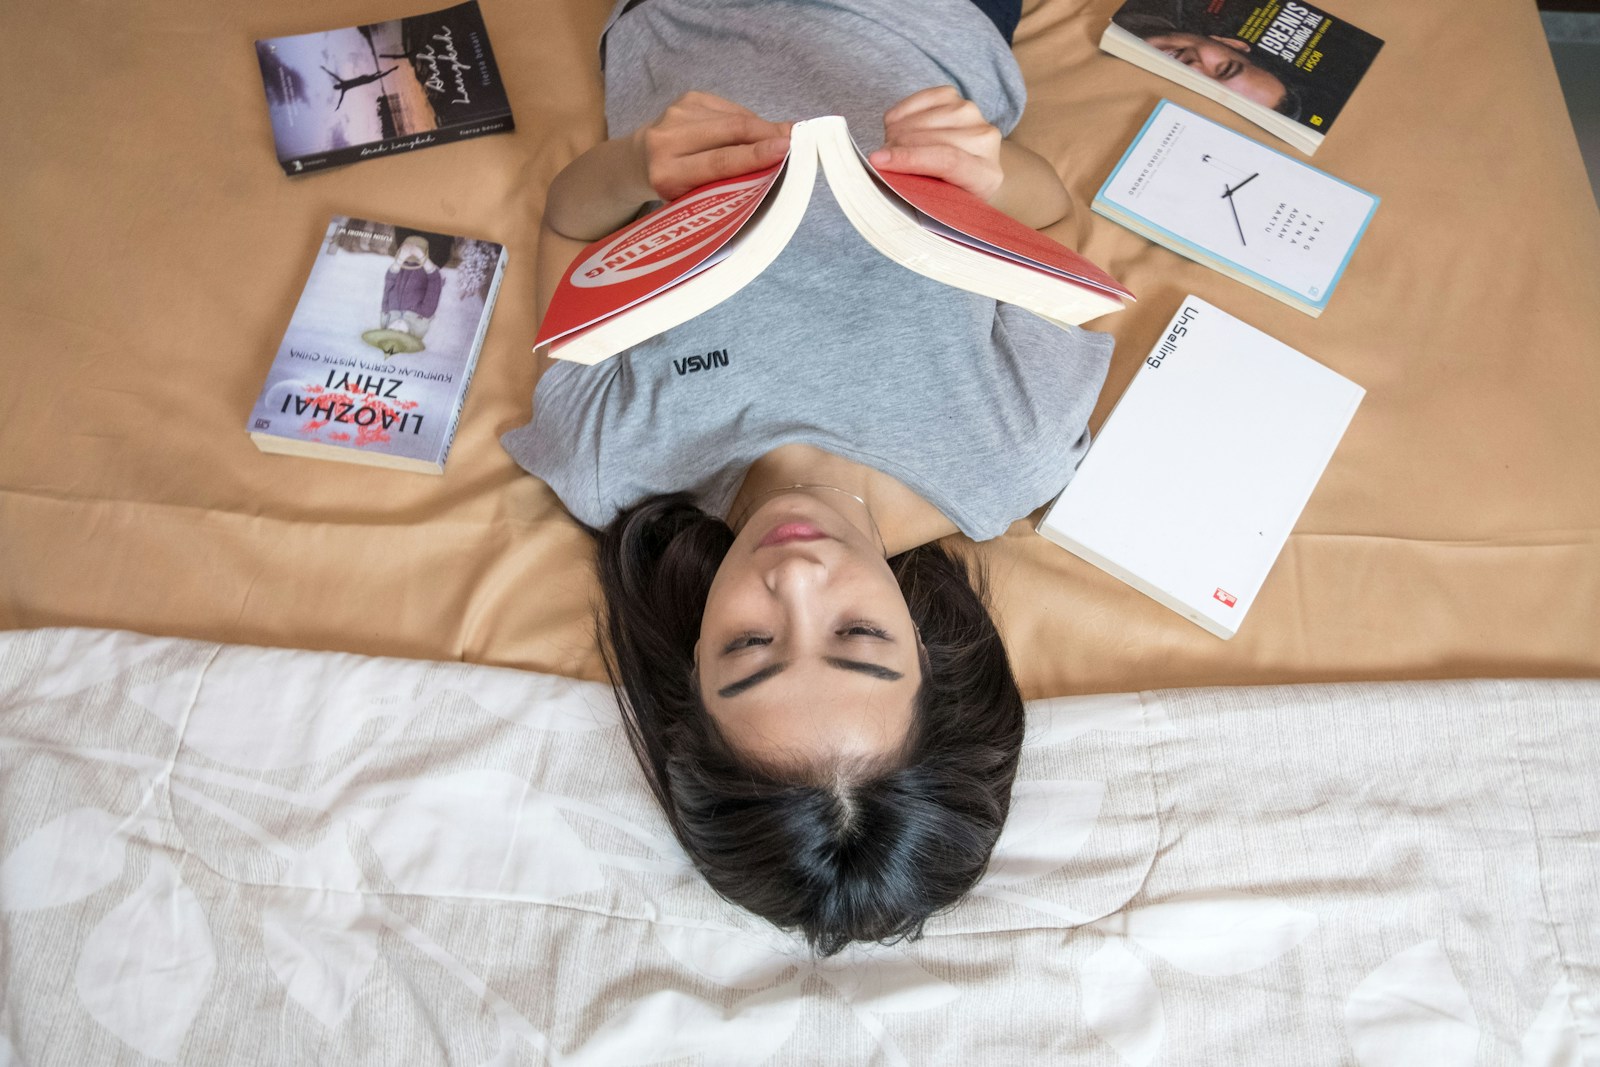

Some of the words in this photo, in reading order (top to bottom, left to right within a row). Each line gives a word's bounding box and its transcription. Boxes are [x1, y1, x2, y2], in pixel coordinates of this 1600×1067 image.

[1257, 1, 1309, 56] SINERGI
[1302, 11, 1324, 29] THE
[1285, 25, 1314, 53] POWER
[416, 44, 446, 93] Arah
[432, 25, 471, 104] Langkah
[1279, 49, 1296, 63] OF
[1161, 121, 1181, 148] SAPARDI
[1147, 147, 1163, 168] DJOKO
[1128, 168, 1149, 196] DAMONO
[1264, 202, 1286, 233] WAKTU
[1277, 207, 1299, 239] ADALAH
[1290, 213, 1312, 245] FANA
[347, 229, 373, 239] HENDRI
[1303, 220, 1324, 251] YANG
[290, 348, 321, 361] CHINA
[323, 355, 357, 368] MISTIK
[360, 361, 396, 374] CERITA
[673, 349, 729, 376] NASA
[325, 369, 403, 398] ZHIYI
[398, 368, 453, 383] KUMPULAN
[281, 393, 424, 435] LIAOZHAI
